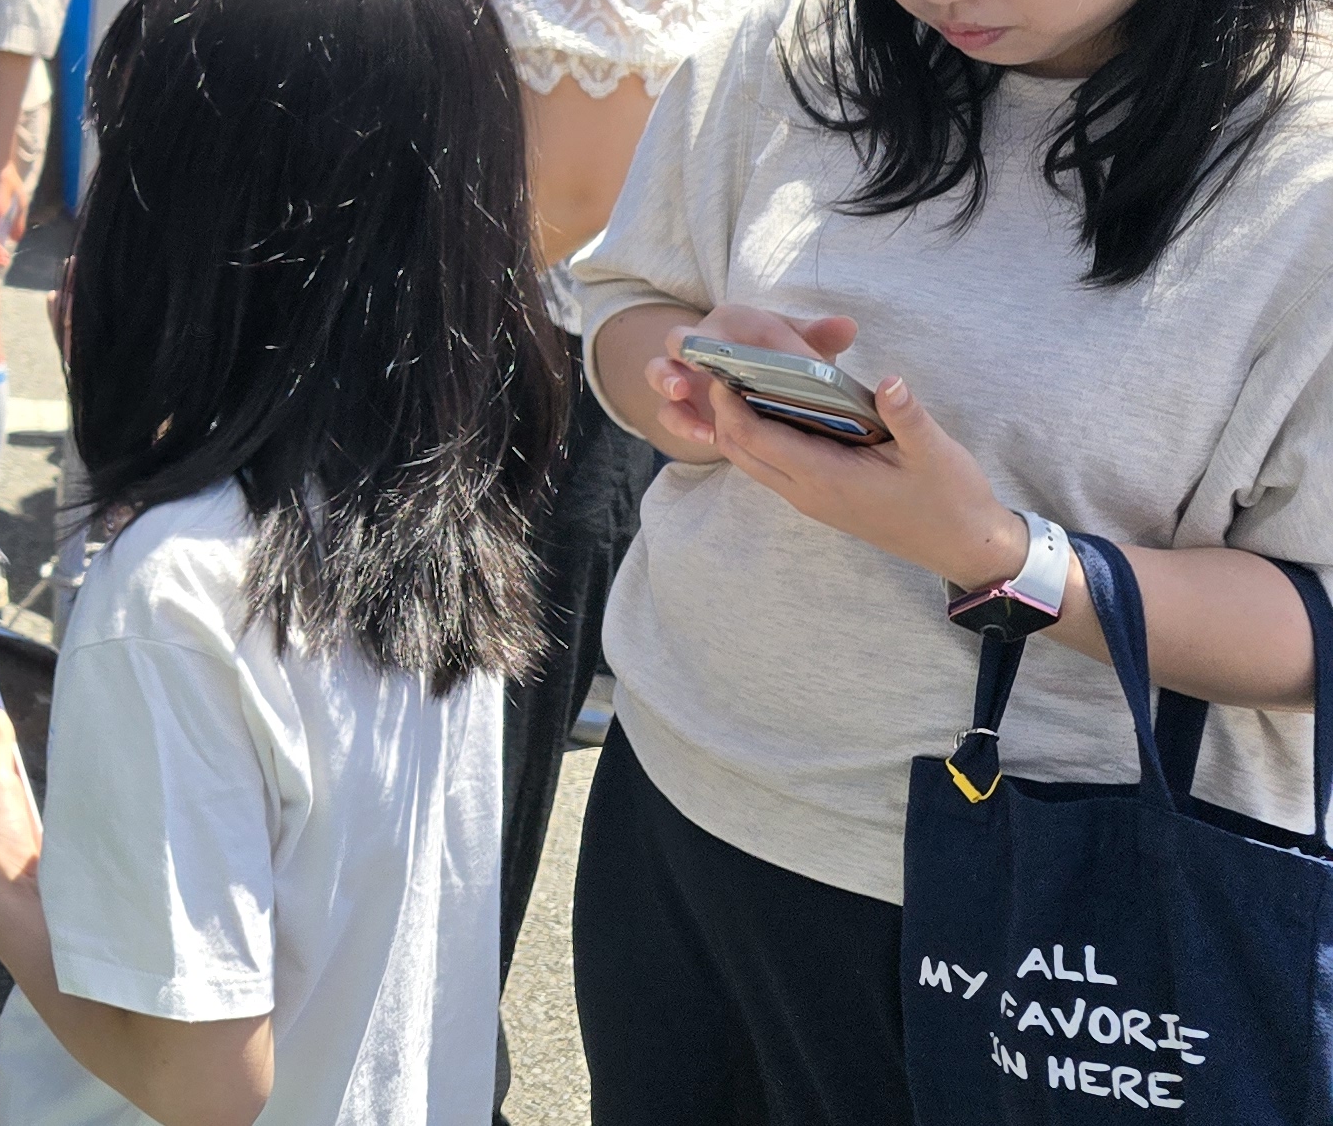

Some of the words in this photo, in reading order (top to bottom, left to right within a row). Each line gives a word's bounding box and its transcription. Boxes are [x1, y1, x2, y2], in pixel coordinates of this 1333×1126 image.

[918, 955, 989, 1000] MY
[1016, 943, 1118, 986] ALL
[989, 1031, 1029, 1080] IN
[1047, 1055, 1186, 1109] HERE
